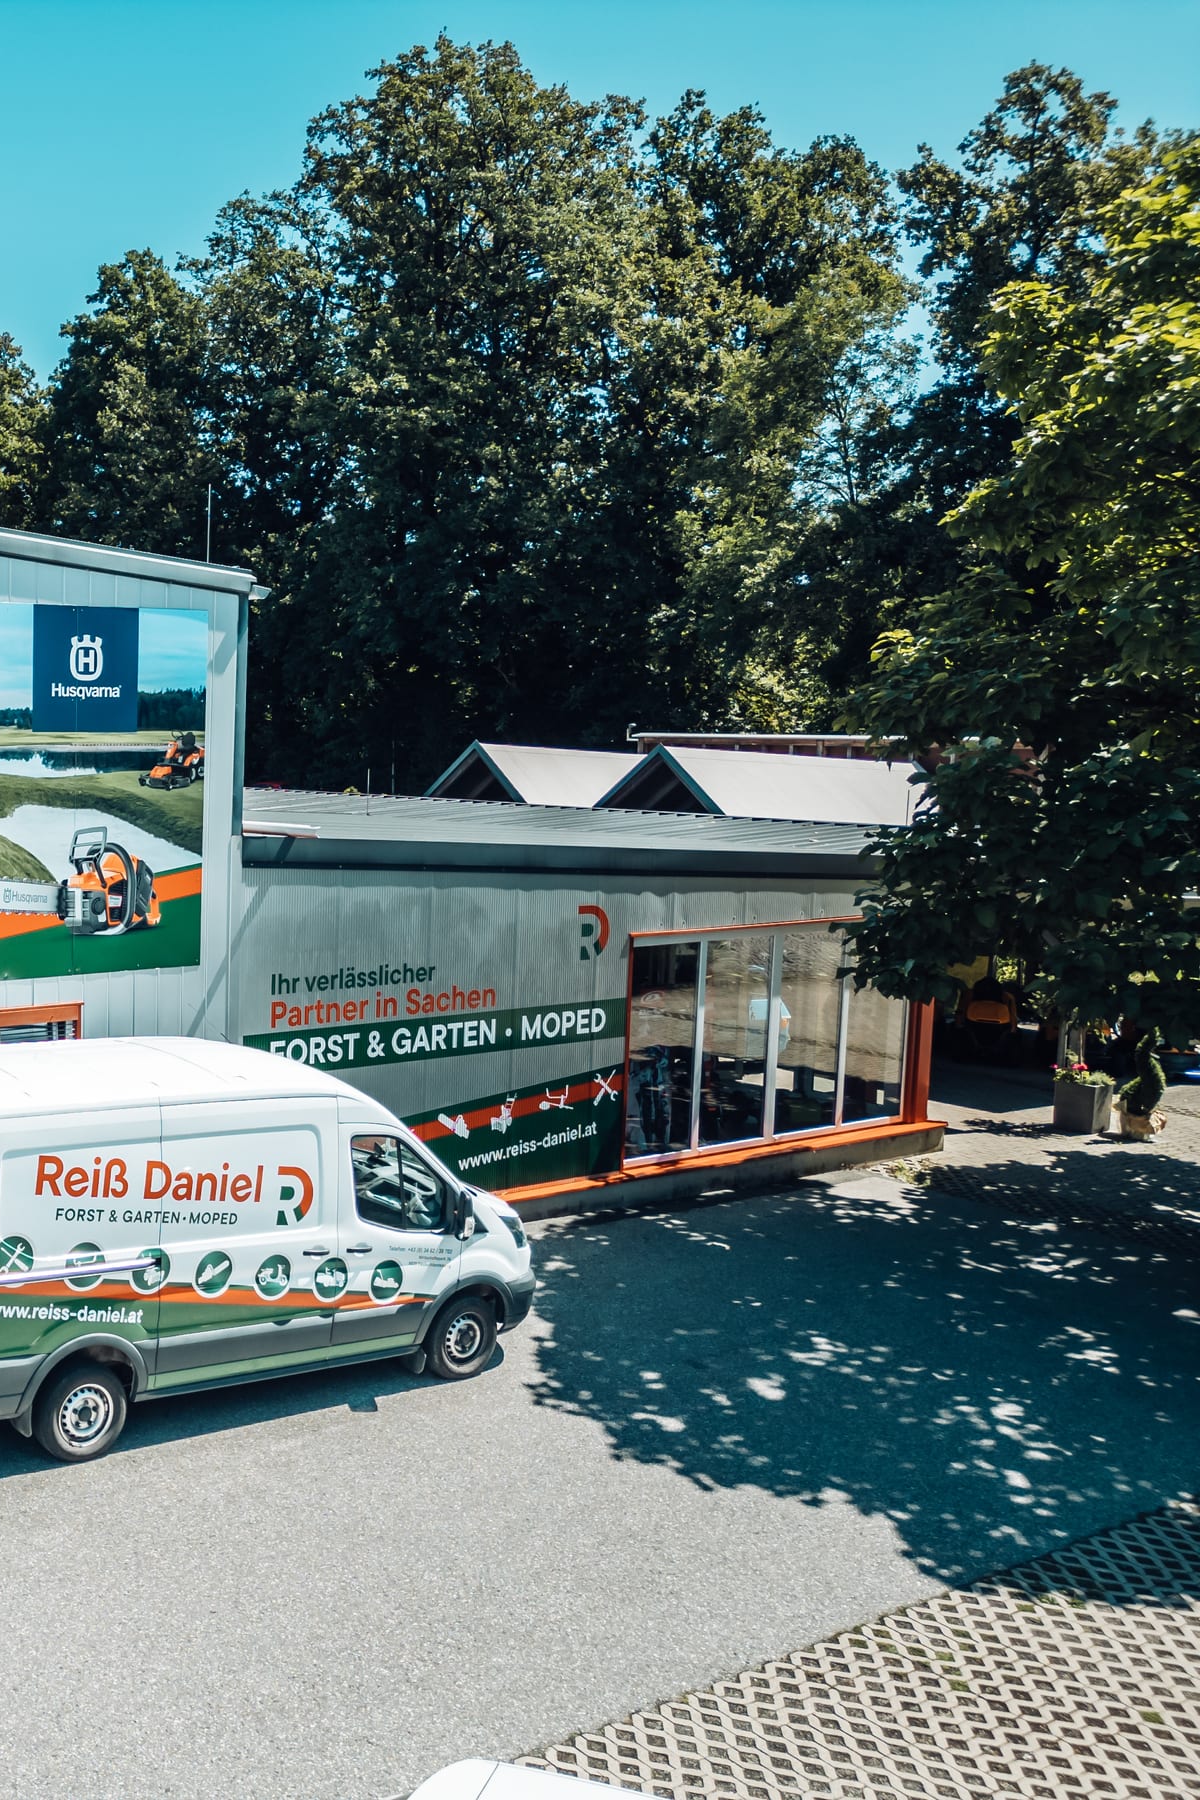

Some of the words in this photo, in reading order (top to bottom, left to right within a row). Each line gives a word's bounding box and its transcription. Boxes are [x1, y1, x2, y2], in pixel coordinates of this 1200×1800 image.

[271, 972, 300, 996] Ihr
[305, 963, 436, 993] verlässlicher
[270, 998, 369, 1029] Partner
[375, 991, 398, 1019] in
[405, 984, 497, 1016] Sachen
[366, 1030, 386, 1058] &
[391, 1018, 498, 1055] GARTEN
[520, 1007, 607, 1042] MOPED
[34, 1154, 129, 1199] Reiß
[143, 1160, 264, 1203] Daniel
[55, 1208, 104, 1223] FORST
[108, 1208, 118, 1223] &
